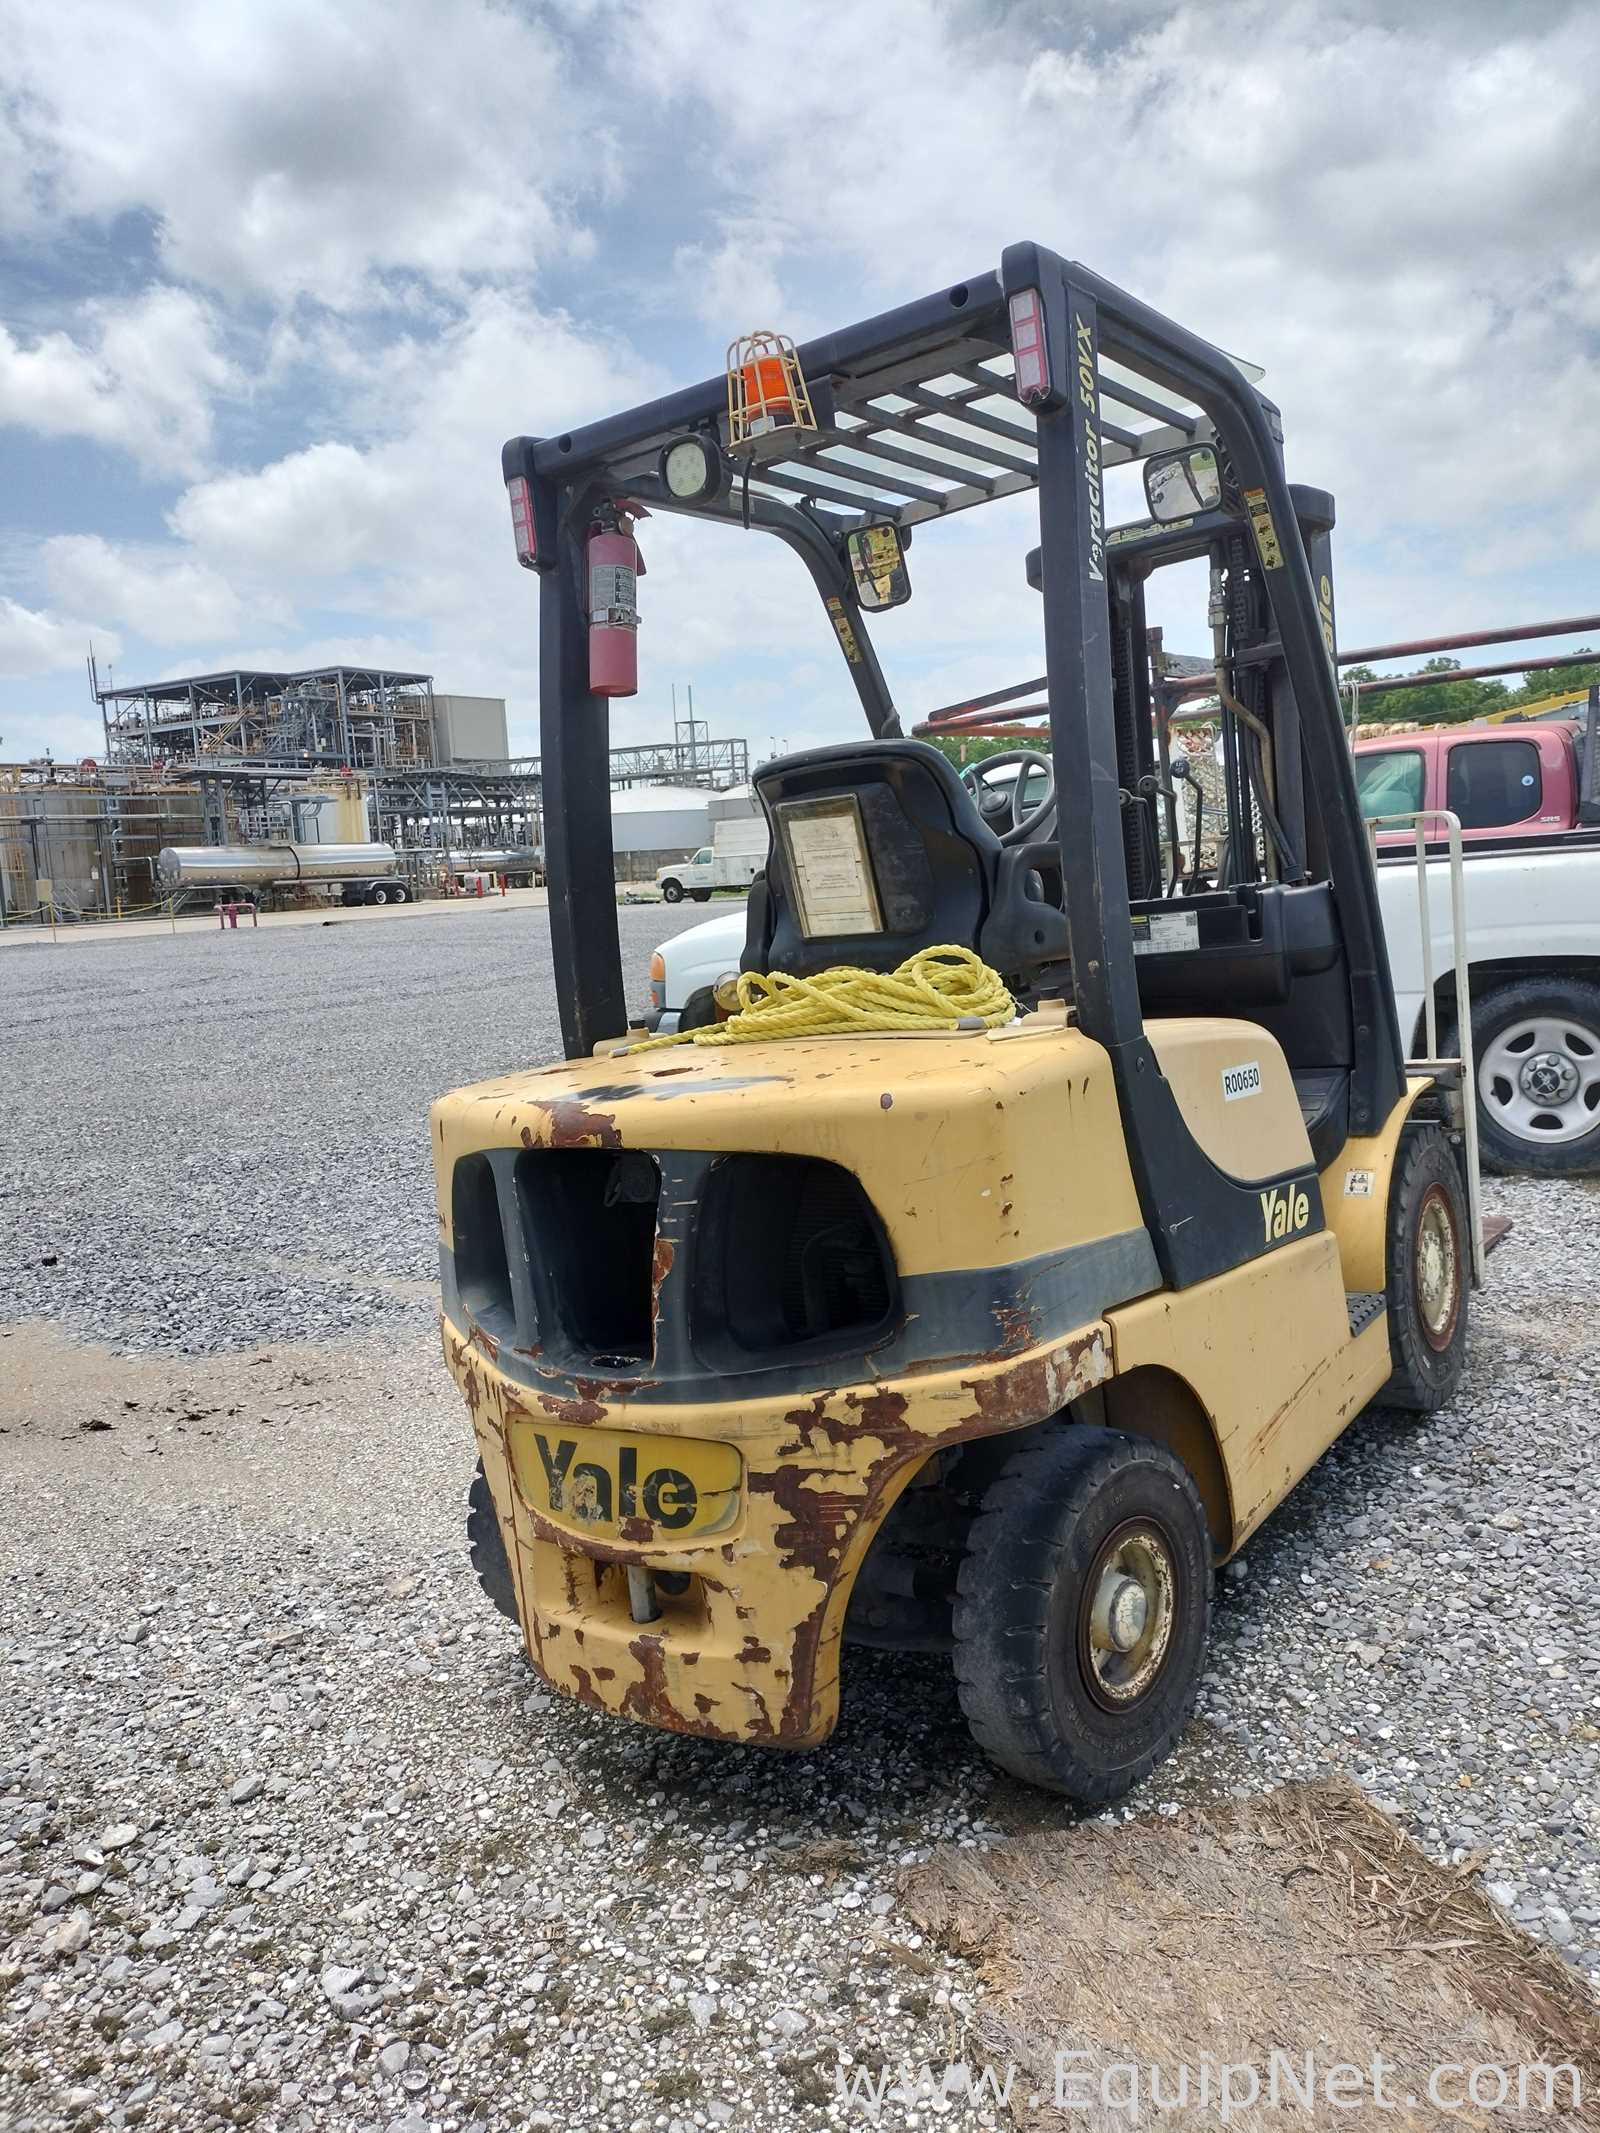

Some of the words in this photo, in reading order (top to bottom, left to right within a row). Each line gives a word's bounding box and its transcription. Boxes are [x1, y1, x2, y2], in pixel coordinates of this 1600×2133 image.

[1075, 312, 1095, 415] 50VX
[1085, 418, 1104, 582] Veracitor
[1319, 575, 1335, 655] ale
[1224, 1068, 1260, 1095] R00650
[1260, 1183, 1309, 1243] Yale
[533, 1432, 698, 1530] Yale
